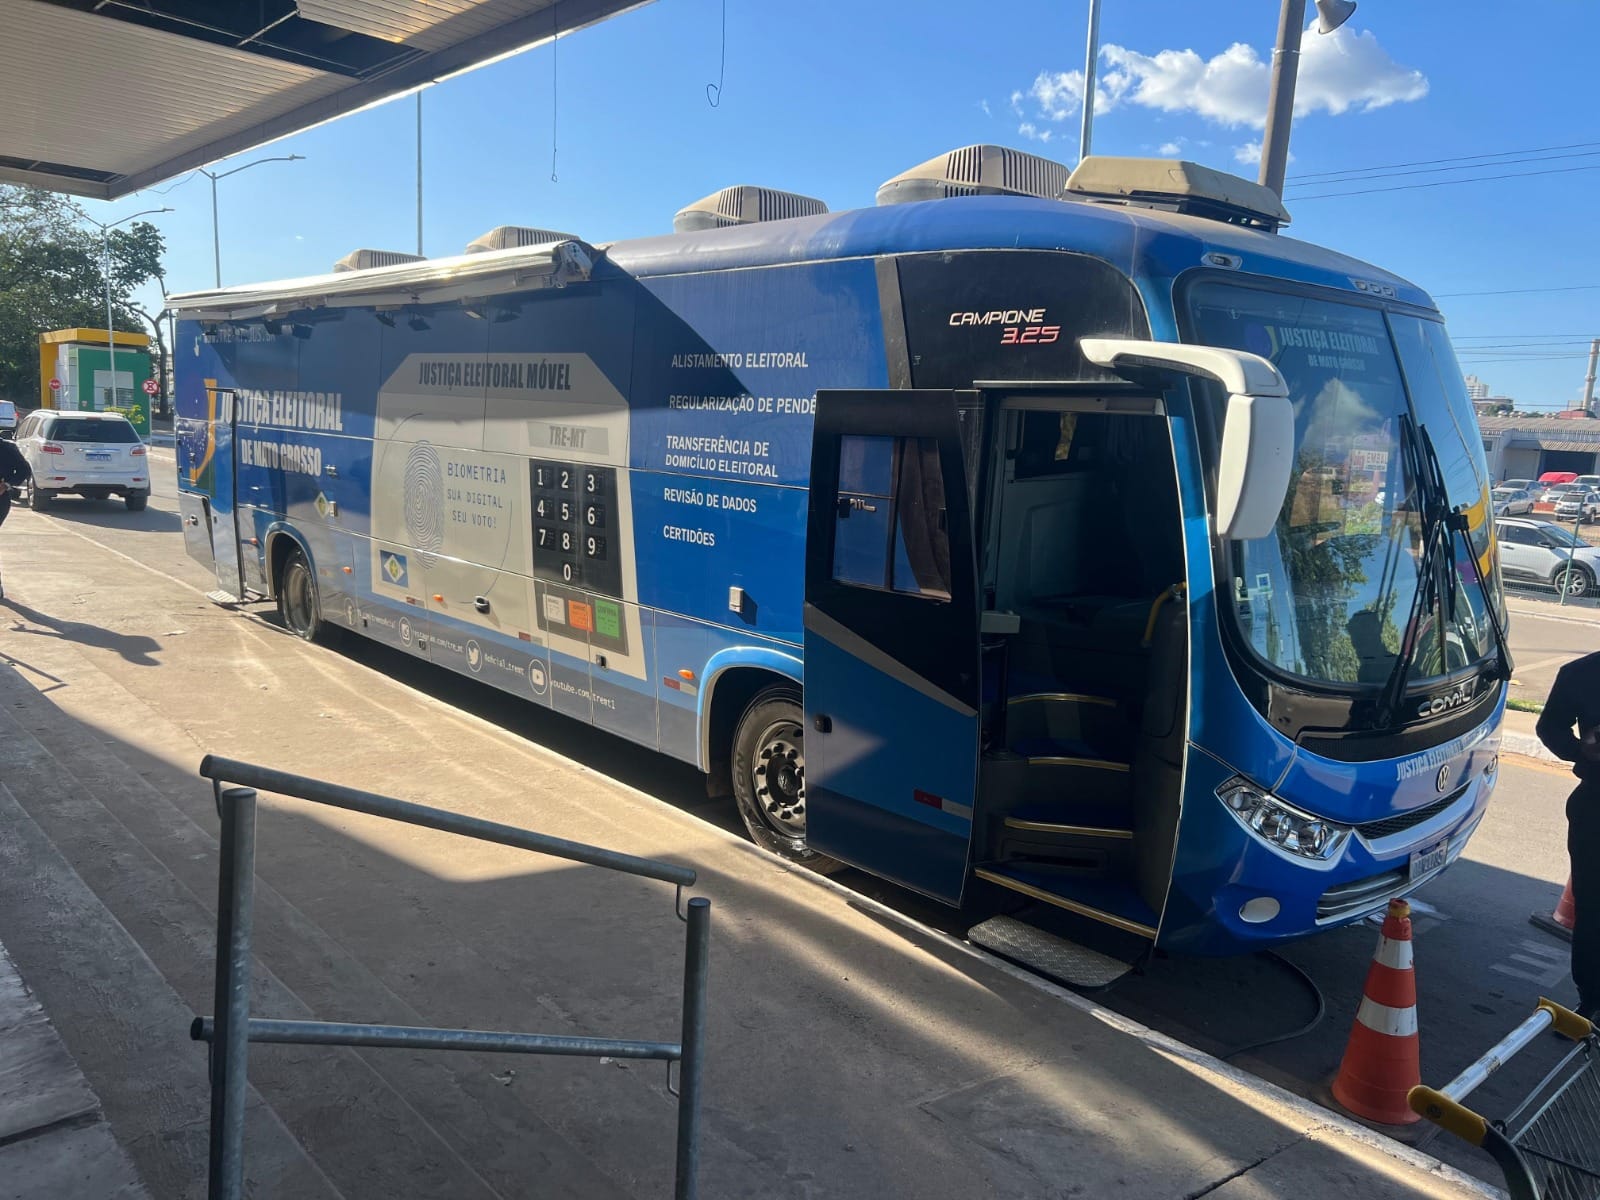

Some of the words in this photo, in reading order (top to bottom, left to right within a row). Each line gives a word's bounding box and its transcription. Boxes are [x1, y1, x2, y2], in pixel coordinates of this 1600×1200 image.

[949, 309, 1046, 326] CAMPIONE
[1000, 326, 1061, 344] 3.25
[1280, 327, 1329, 352] JUSTIÇA
[1328, 331, 1379, 354] ELEITORAL
[671, 353, 743, 368] ALISTAMENTO
[746, 352, 809, 368] ELEITORAL
[418, 362, 462, 390] JUSTIÇA
[463, 362, 523, 389] ELEITORAL
[526, 358, 571, 390] MÓVEL
[221, 388, 270, 434] JUSTIÇA
[272, 389, 343, 431] ELEITORAL
[669, 393, 754, 415] REGULARIZAÇÃO
[757, 397, 773, 413] DE
[776, 394, 817, 415] PENDÊ
[549, 425, 586, 449] TRE-MT
[666, 435, 750, 456] TRANSFERÊNCIA
[753, 442, 769, 457] DE
[241, 439, 253, 465] DE
[254, 440, 279, 469] MATO
[280, 443, 322, 476] GROSSO
[665, 454, 717, 471] DOMICÍLIO
[718, 459, 778, 478] ELEITORAL
[447, 462, 506, 484] BIOMETRIA
[537, 468, 544, 486] 1
[561, 471, 569, 489] 2
[587, 474, 595, 493] 3
[447, 488, 462, 501] SUA
[466, 491, 503, 509] DIGITAL
[664, 487, 704, 506] REVISÃO
[706, 494, 719, 508] DE
[722, 495, 757, 513] DADOS
[452, 510, 467, 523] SEU
[537, 499, 545, 517] 4
[561, 503, 569, 521] 5
[587, 506, 595, 525] 6
[539, 529, 546, 546] 7
[562, 532, 571, 550] 8
[587, 537, 596, 556] 9
[663, 525, 715, 546] CERTIDÕES
[563, 563, 571, 581] 0
[1417, 688, 1471, 717] COMIL
[1396, 751, 1430, 781] JUSTIÇA
